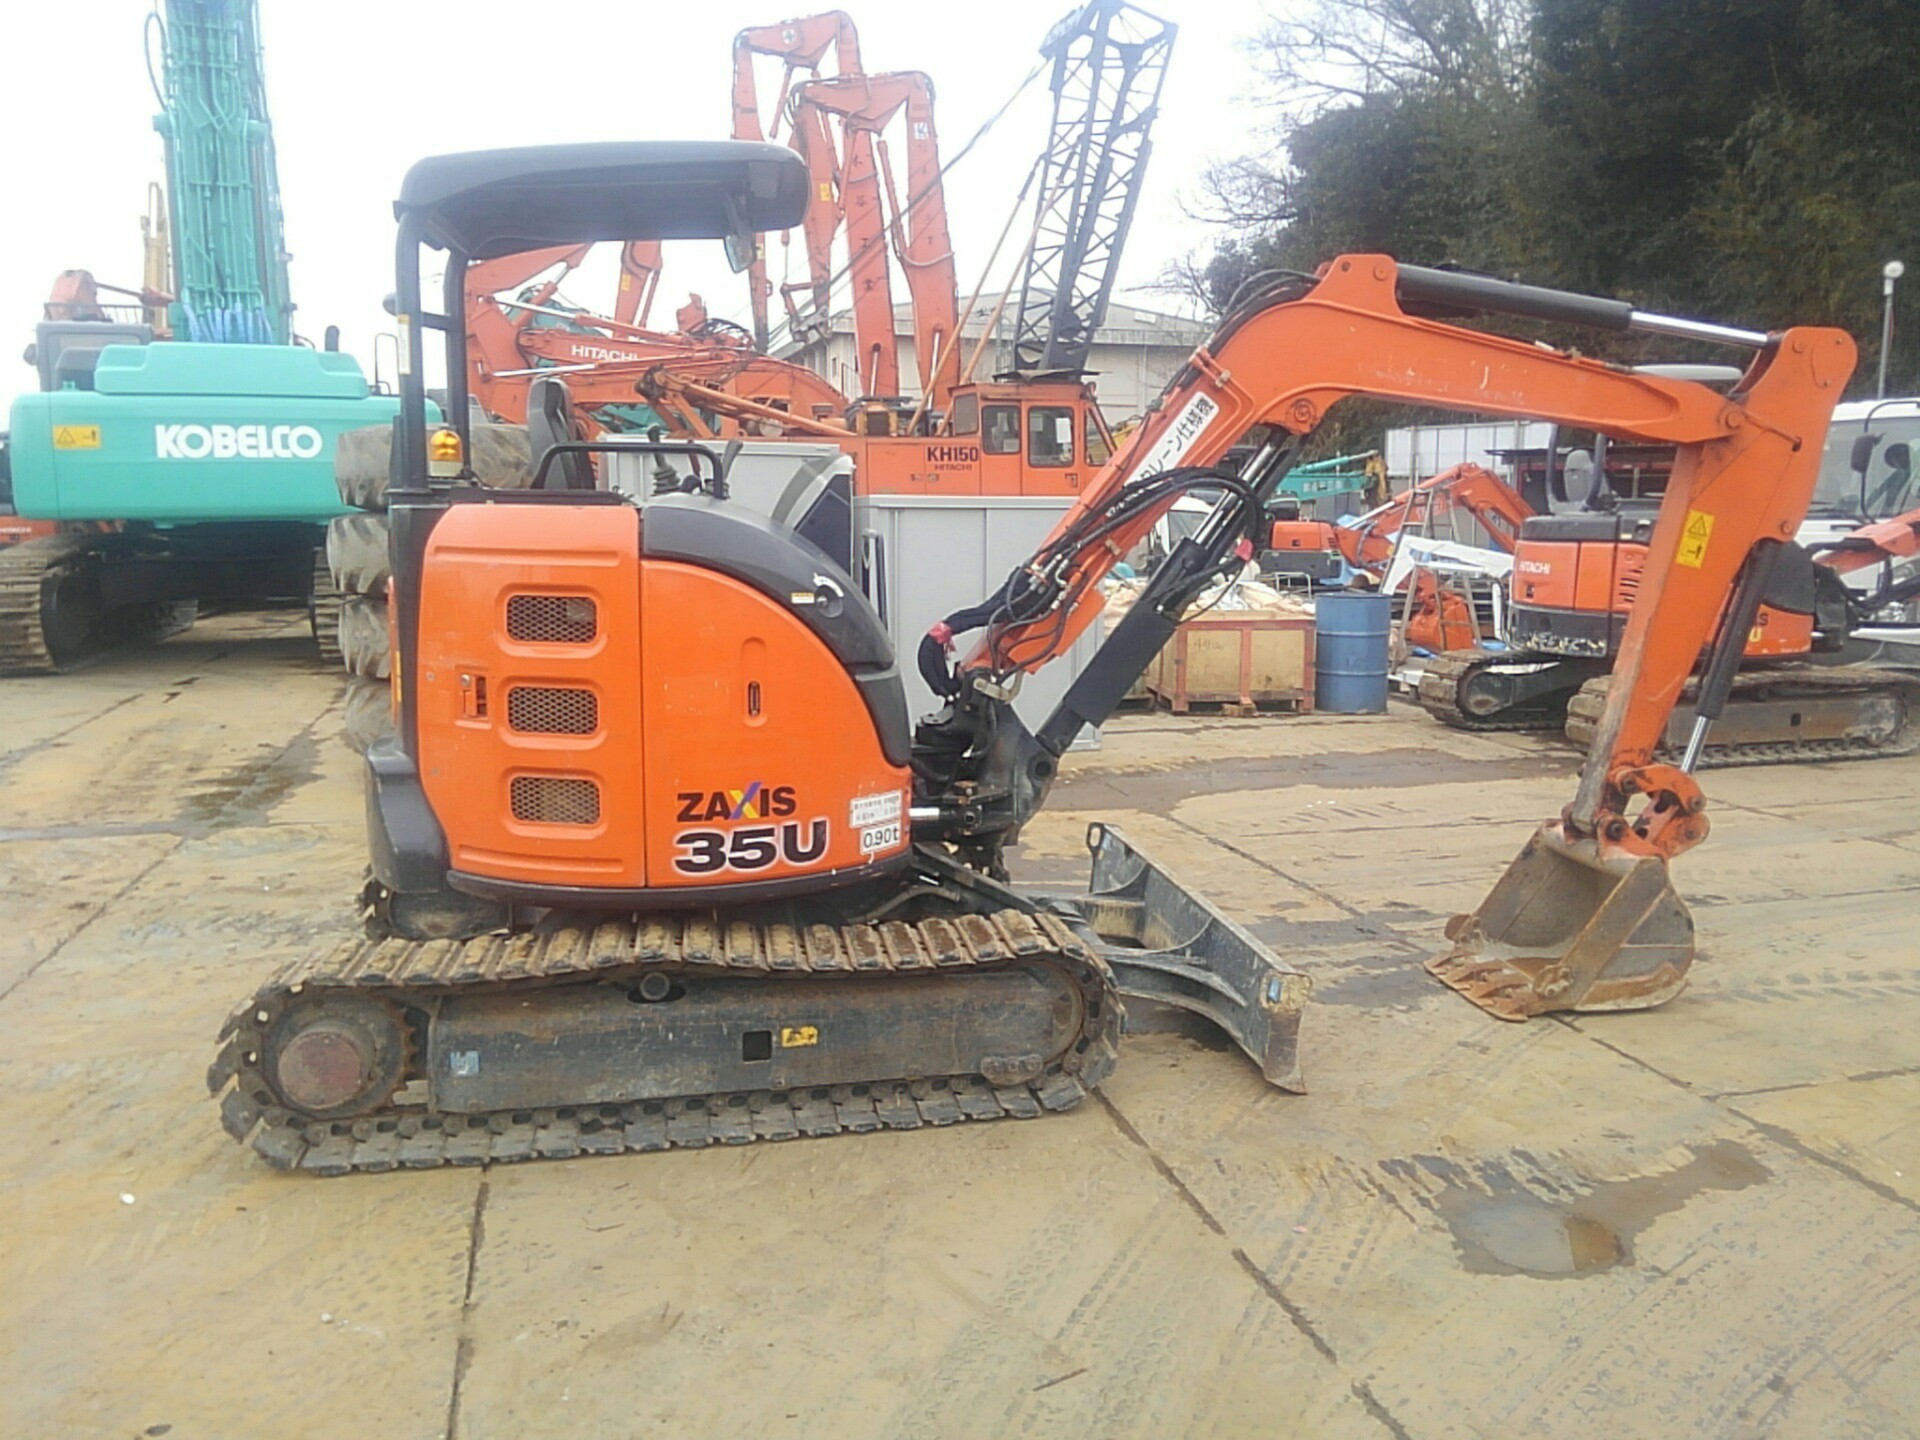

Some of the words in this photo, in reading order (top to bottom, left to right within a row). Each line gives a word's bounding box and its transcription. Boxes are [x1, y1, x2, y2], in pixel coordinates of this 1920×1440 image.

[571, 345, 638, 361] HITACHI
[155, 424, 323, 459] KOBELCO
[927, 446, 979, 462] KH150
[676, 781, 797, 822] ZAXIS
[674, 818, 828, 875] 35U
